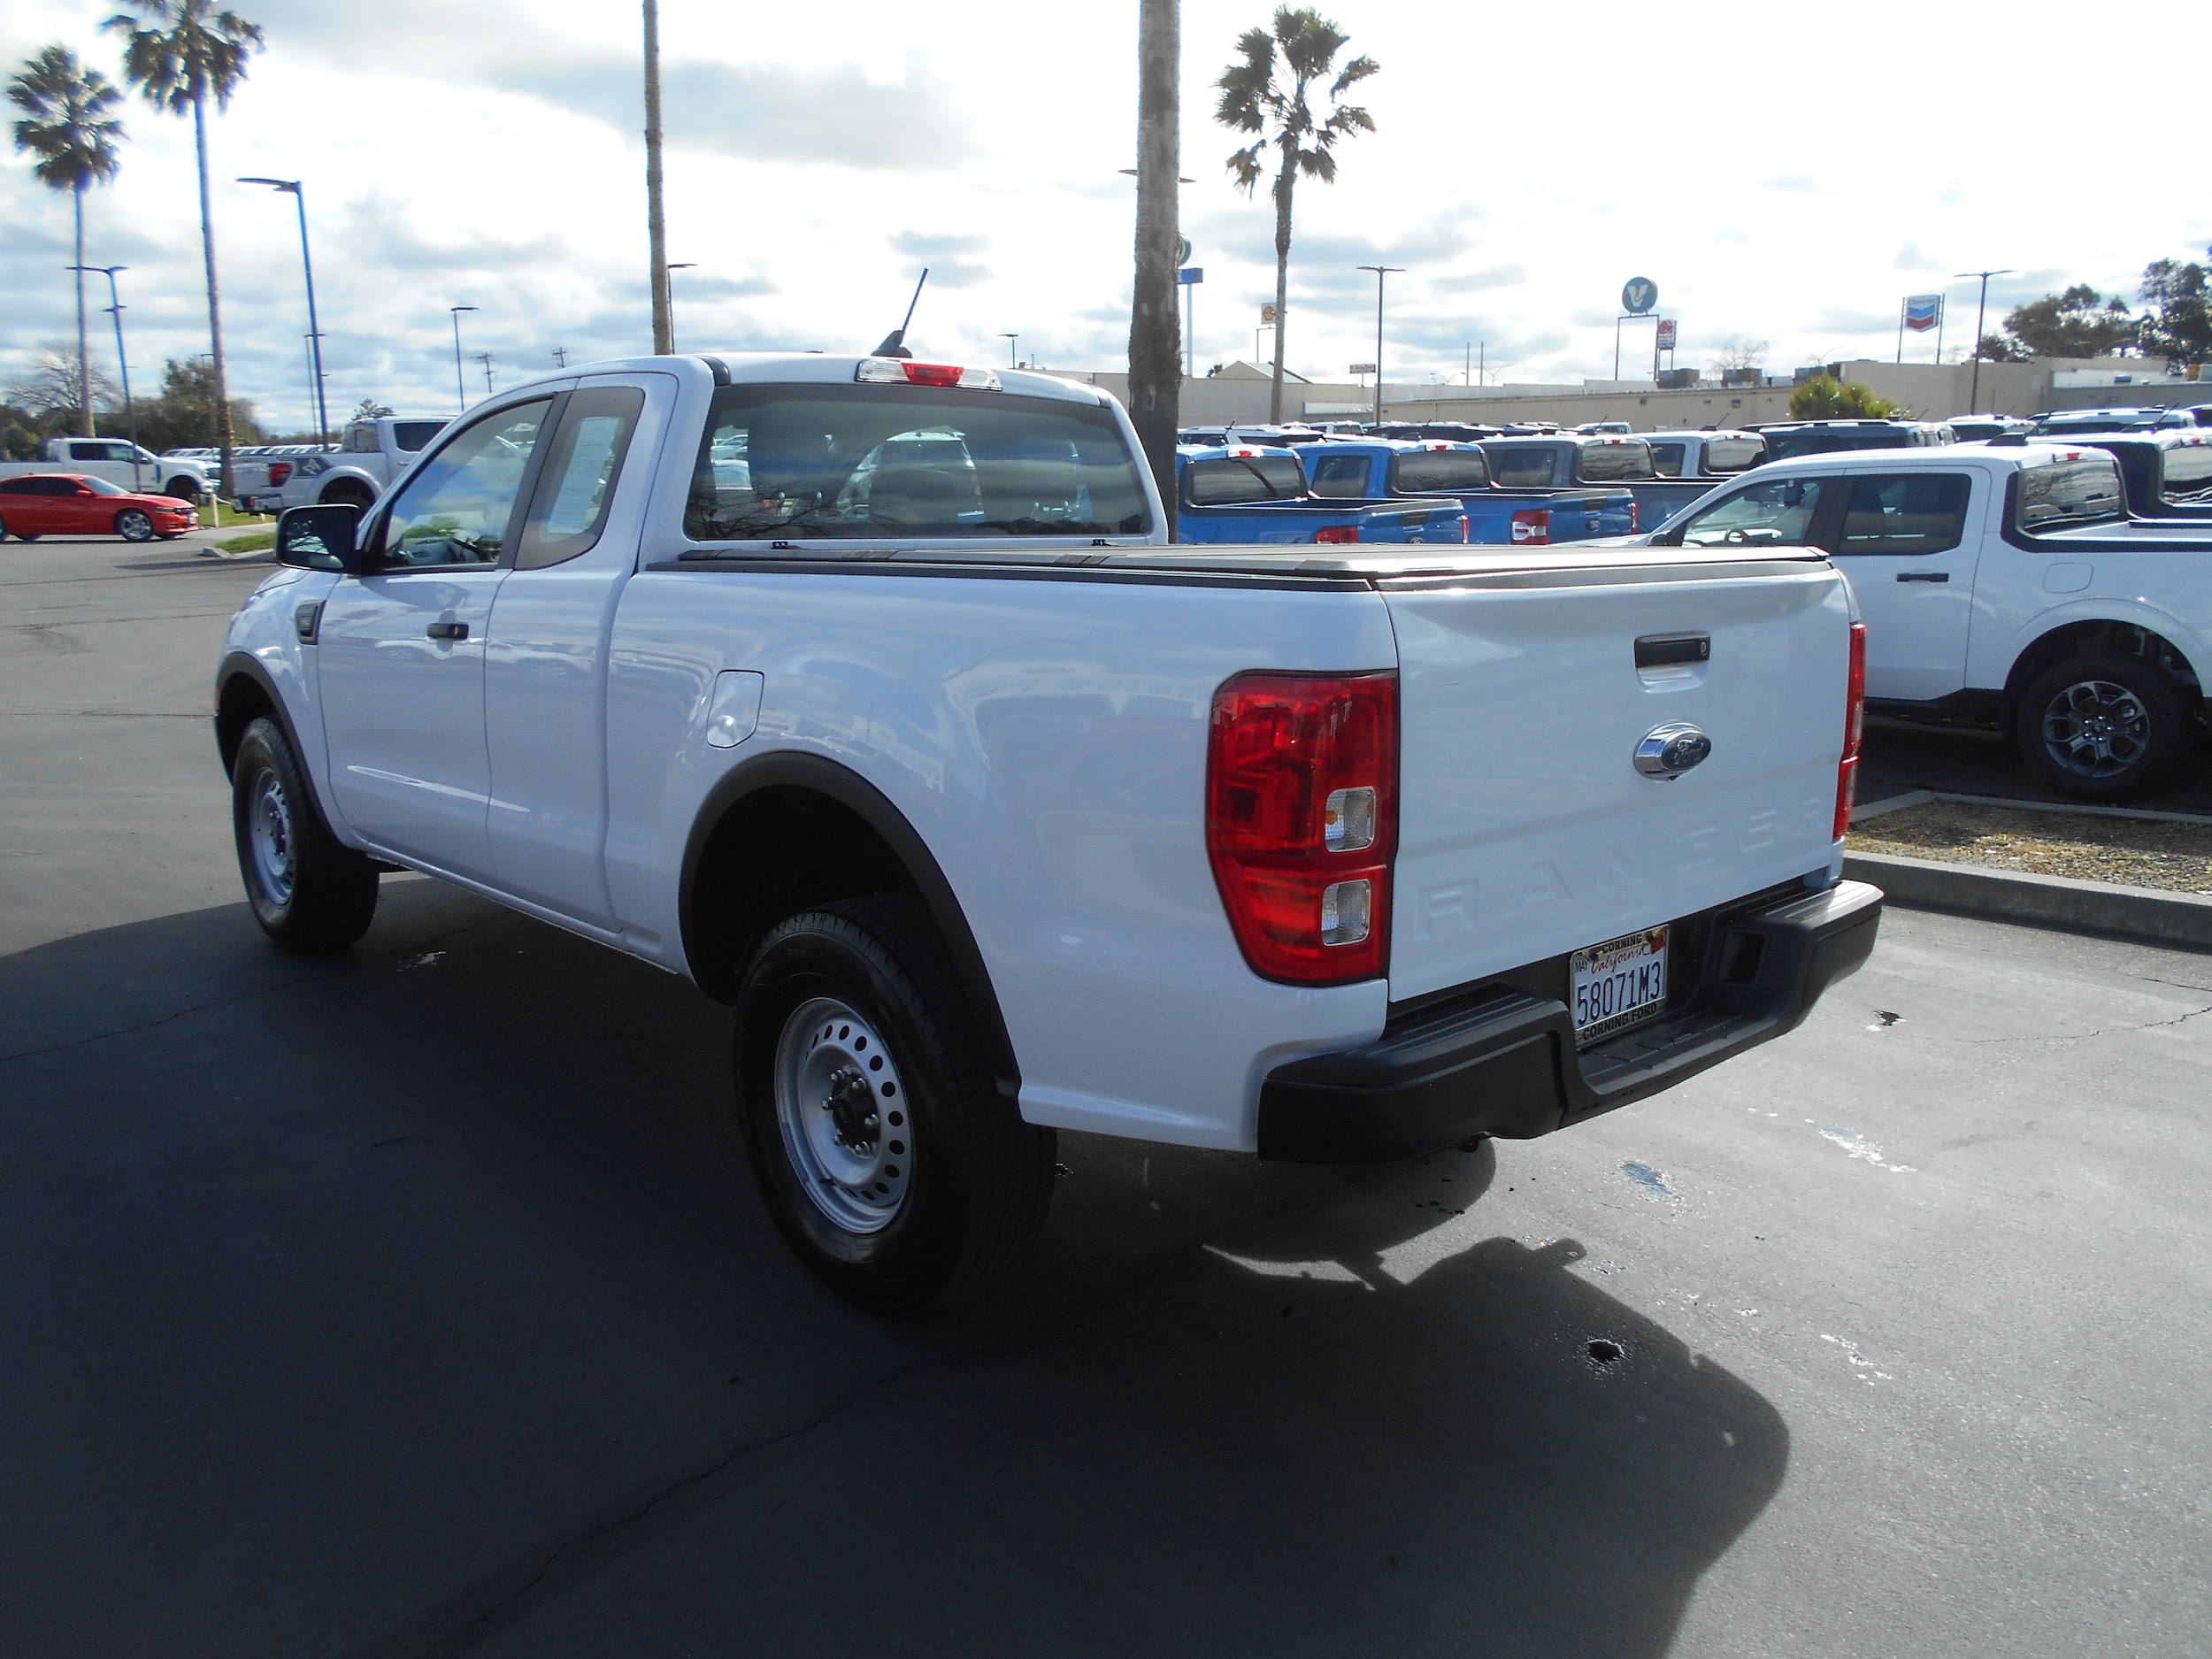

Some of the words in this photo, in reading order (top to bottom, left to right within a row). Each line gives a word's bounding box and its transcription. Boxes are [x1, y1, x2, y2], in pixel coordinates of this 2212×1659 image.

[1602, 933, 1643, 955] CORNING
[1575, 961, 1587, 973] MAY
[1591, 946, 1650, 973] California
[1577, 961, 1661, 1025] 58071M3
[1583, 1013, 1630, 1041] CORNING
[1632, 1002, 1657, 1021] FORD
